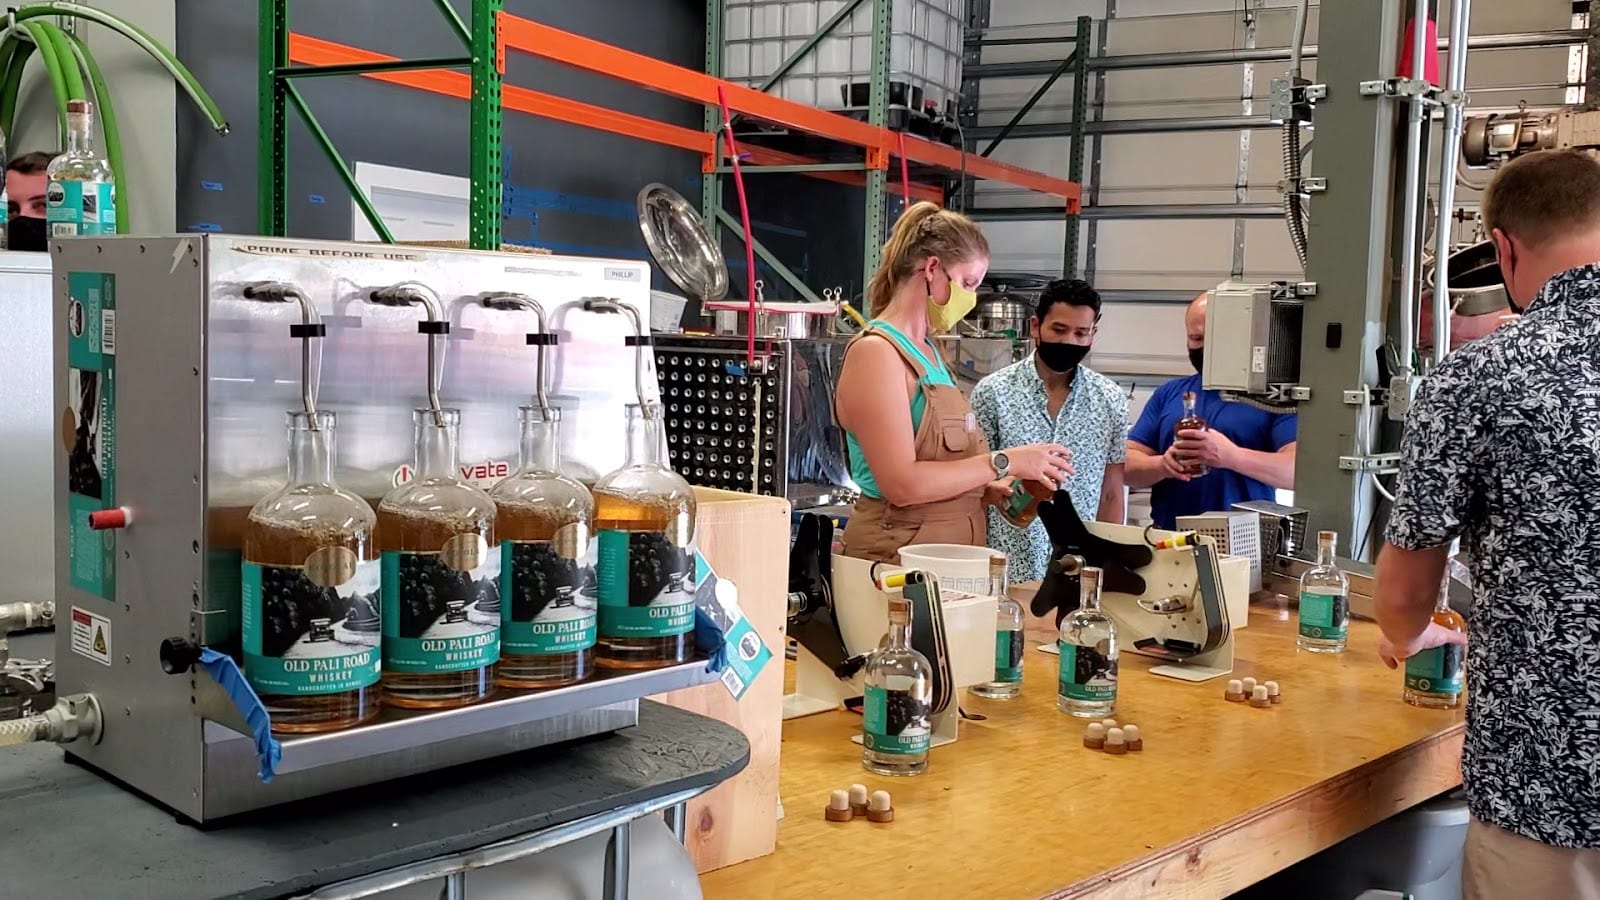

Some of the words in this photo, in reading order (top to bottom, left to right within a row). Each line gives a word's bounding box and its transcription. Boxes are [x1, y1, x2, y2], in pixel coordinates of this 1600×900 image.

[247, 245, 299, 255] PRIME
[309, 249, 375, 259] BEFORE
[383, 253, 416, 261] USE
[611, 271, 634, 279] PHILLIP
[649, 608, 669, 619] OLD
[533, 624, 555, 635] OLD
[558, 621, 578, 633] PALI
[421, 640, 446, 652] OLD
[449, 638, 472, 650] PALI
[474, 632, 496, 648] ROAD
[284, 660, 310, 672] OLD
[314, 658, 340, 671] PALI
[343, 652, 370, 669] ROAD
[445, 649, 483, 662] WHISKEY
[309, 670, 353, 683] WHISKEY
